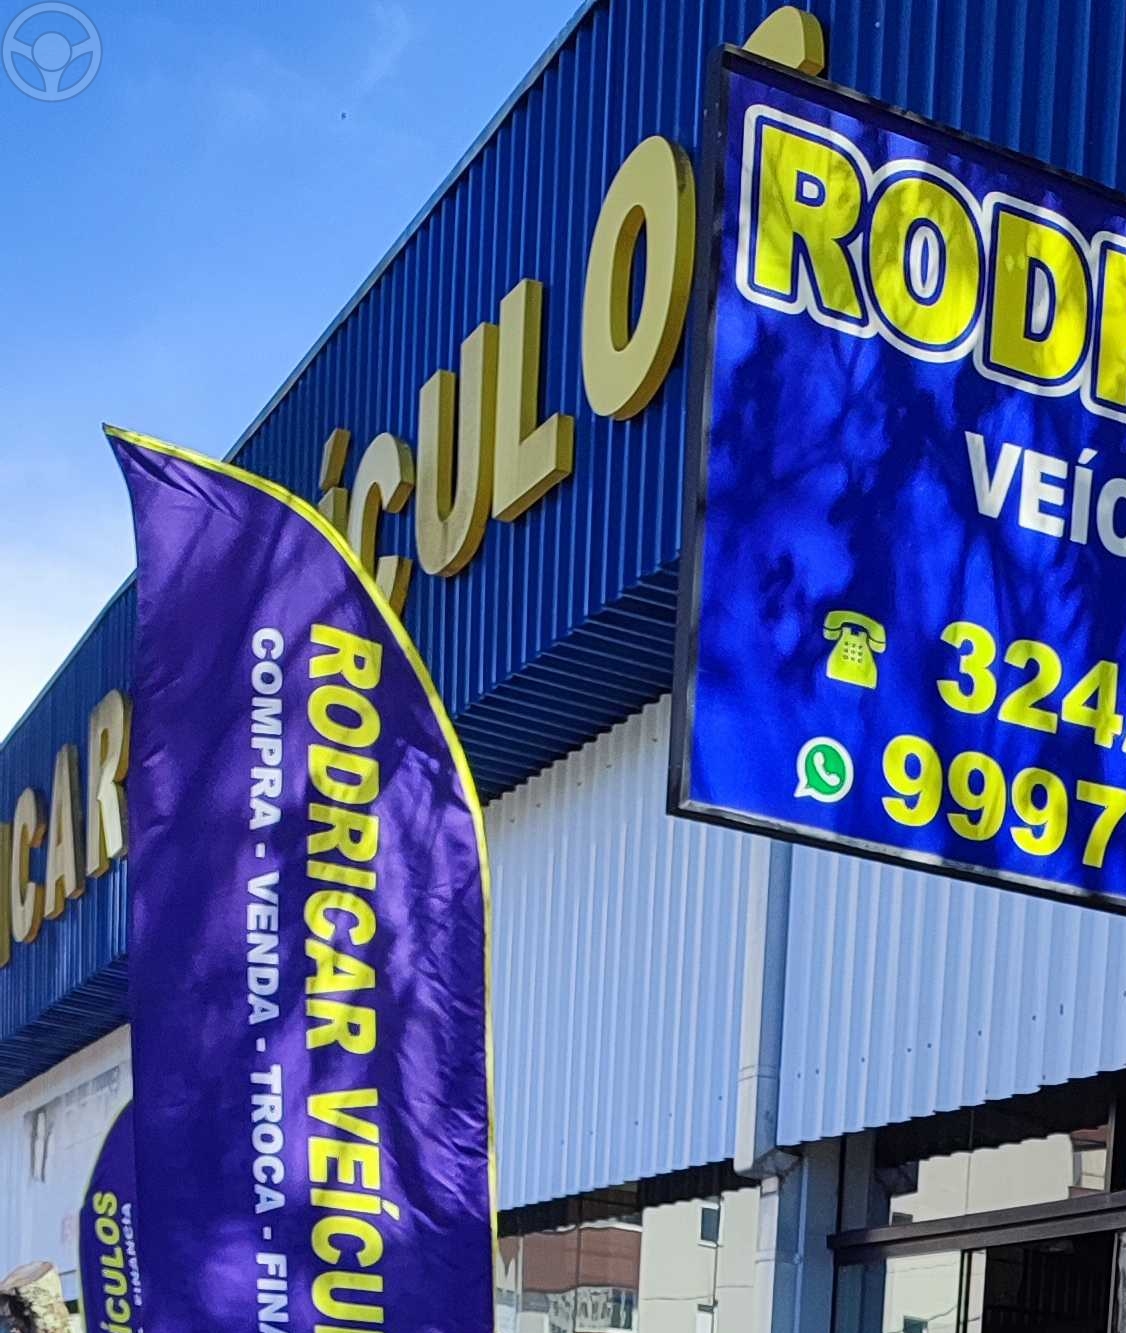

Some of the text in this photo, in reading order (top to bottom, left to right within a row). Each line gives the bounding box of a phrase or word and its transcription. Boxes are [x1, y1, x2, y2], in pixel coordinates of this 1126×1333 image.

[249, 627, 284, 831] COMPRA
[308, 623, 383, 1055] RODRICAR
[246, 870, 280, 1025] VENDA
[250, 1063, 286, 1214] TROCA
